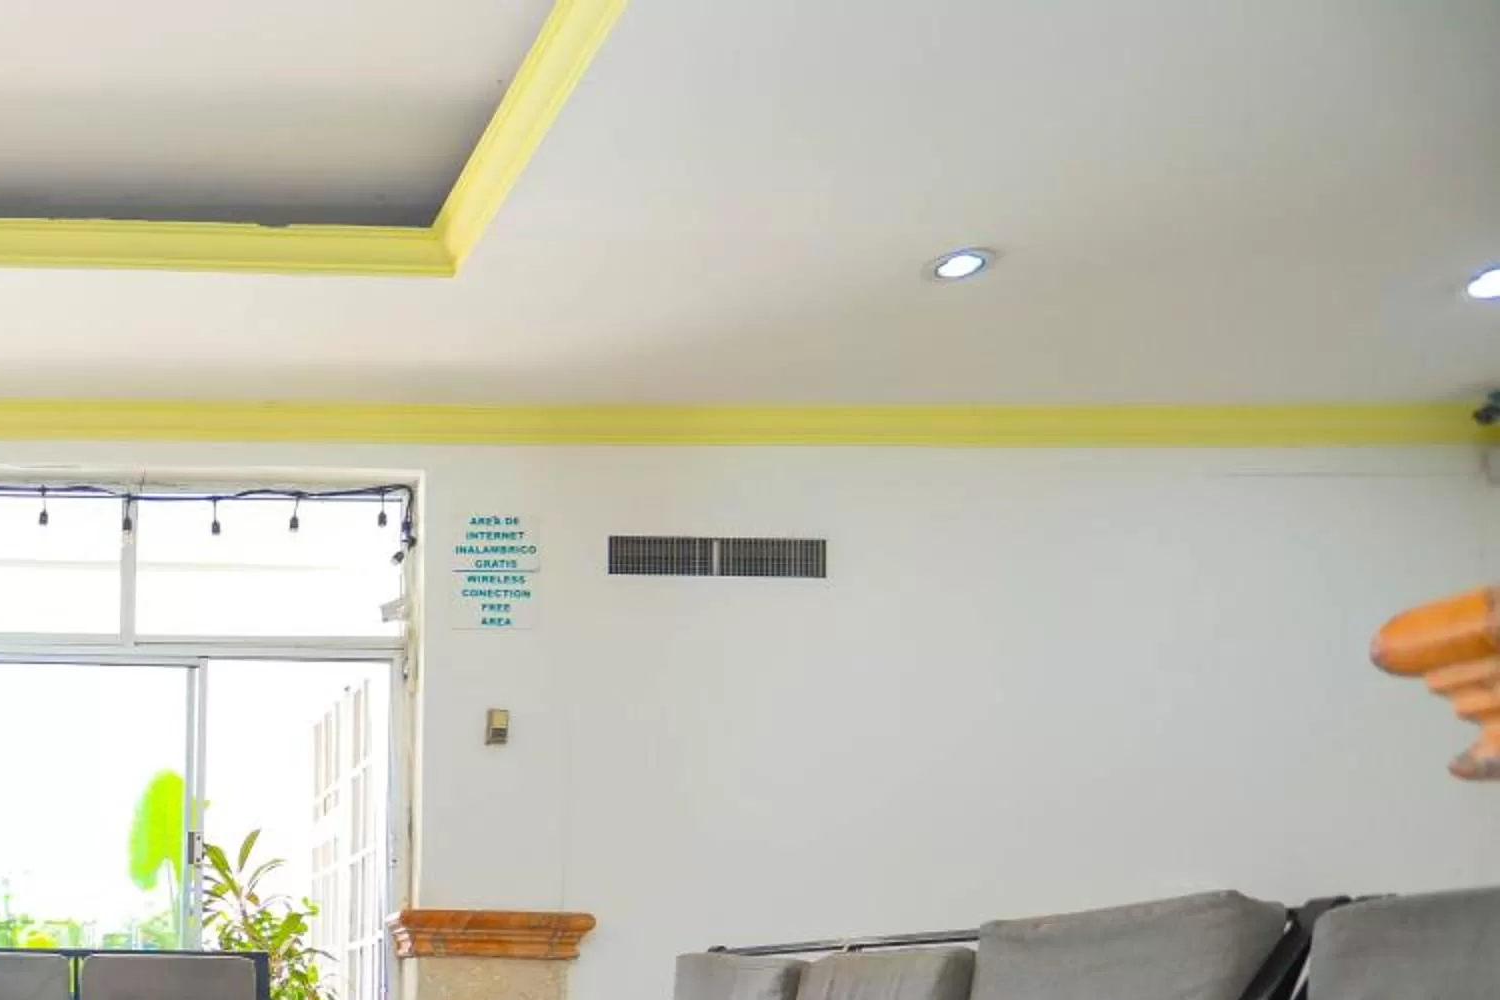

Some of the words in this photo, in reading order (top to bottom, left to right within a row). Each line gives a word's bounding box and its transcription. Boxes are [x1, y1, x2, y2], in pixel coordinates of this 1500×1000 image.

[465, 531, 525, 541] INTERNET
[455, 545, 537, 555] INALAMBRICO
[474, 559, 517, 569] GRATIS
[466, 575, 526, 585] WIRELESS
[461, 589, 531, 599] CONECTION
[481, 603, 511, 612] FREE
[480, 617, 512, 626] AREA
